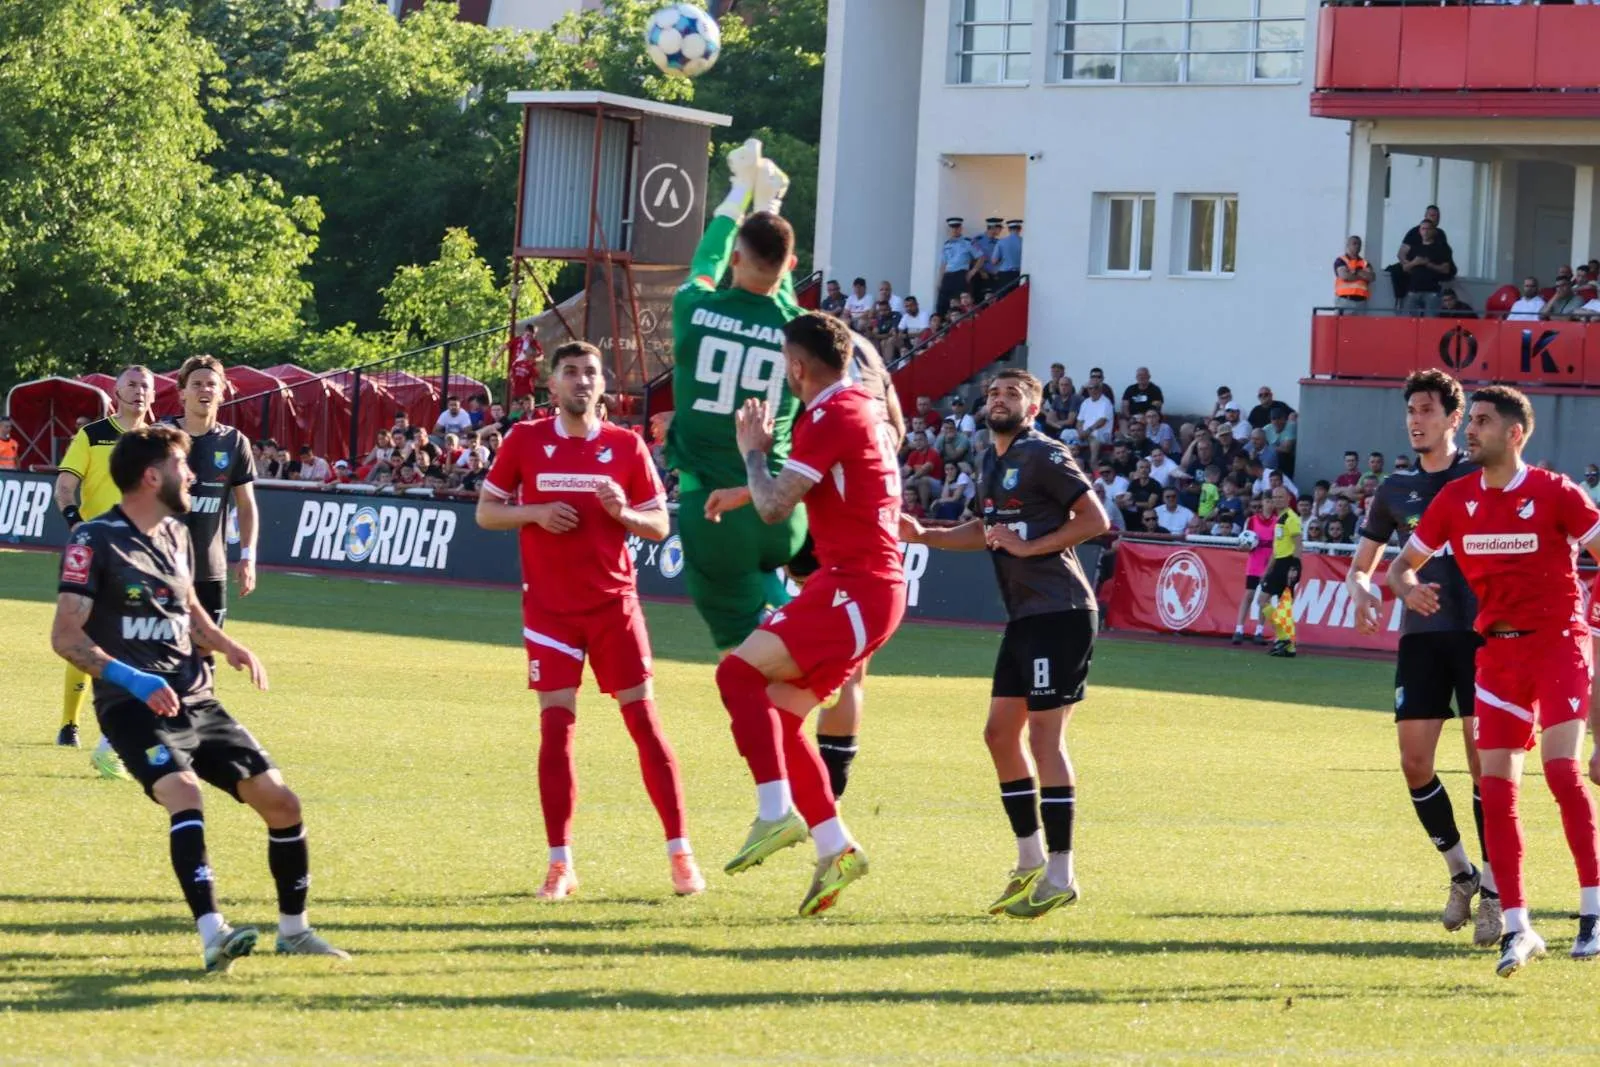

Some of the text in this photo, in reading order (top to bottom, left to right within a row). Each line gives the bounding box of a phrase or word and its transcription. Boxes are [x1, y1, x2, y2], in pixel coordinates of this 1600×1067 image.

[692, 336, 787, 419] 99
[540, 477, 610, 489] meridianb
[0, 480, 53, 537] DER
[1466, 538, 1534, 551] meridianbet
[1033, 657, 1050, 688] 8
